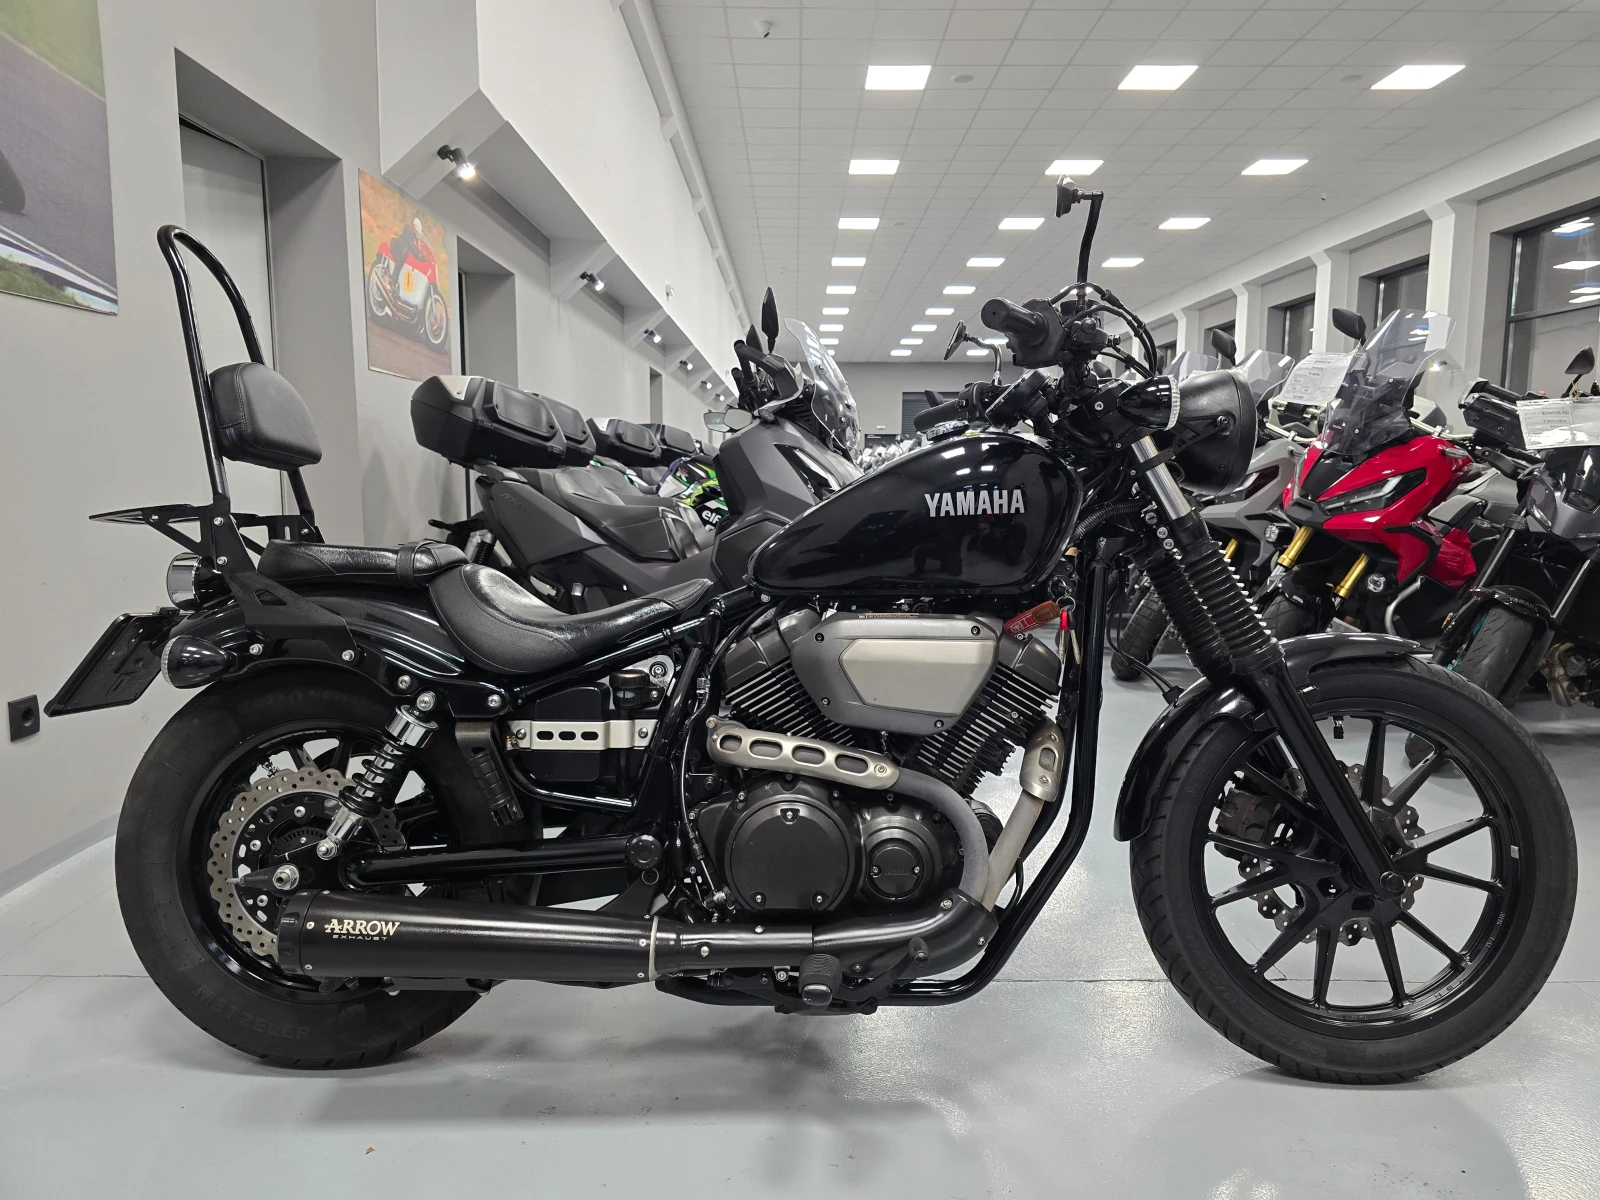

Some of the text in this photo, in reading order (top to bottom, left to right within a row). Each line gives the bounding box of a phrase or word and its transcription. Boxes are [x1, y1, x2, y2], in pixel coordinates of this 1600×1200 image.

[924, 489, 1025, 517] YAMAHA
[701, 509, 722, 524] elf
[323, 918, 400, 936] ARROW
[192, 983, 311, 1040] METZELER
